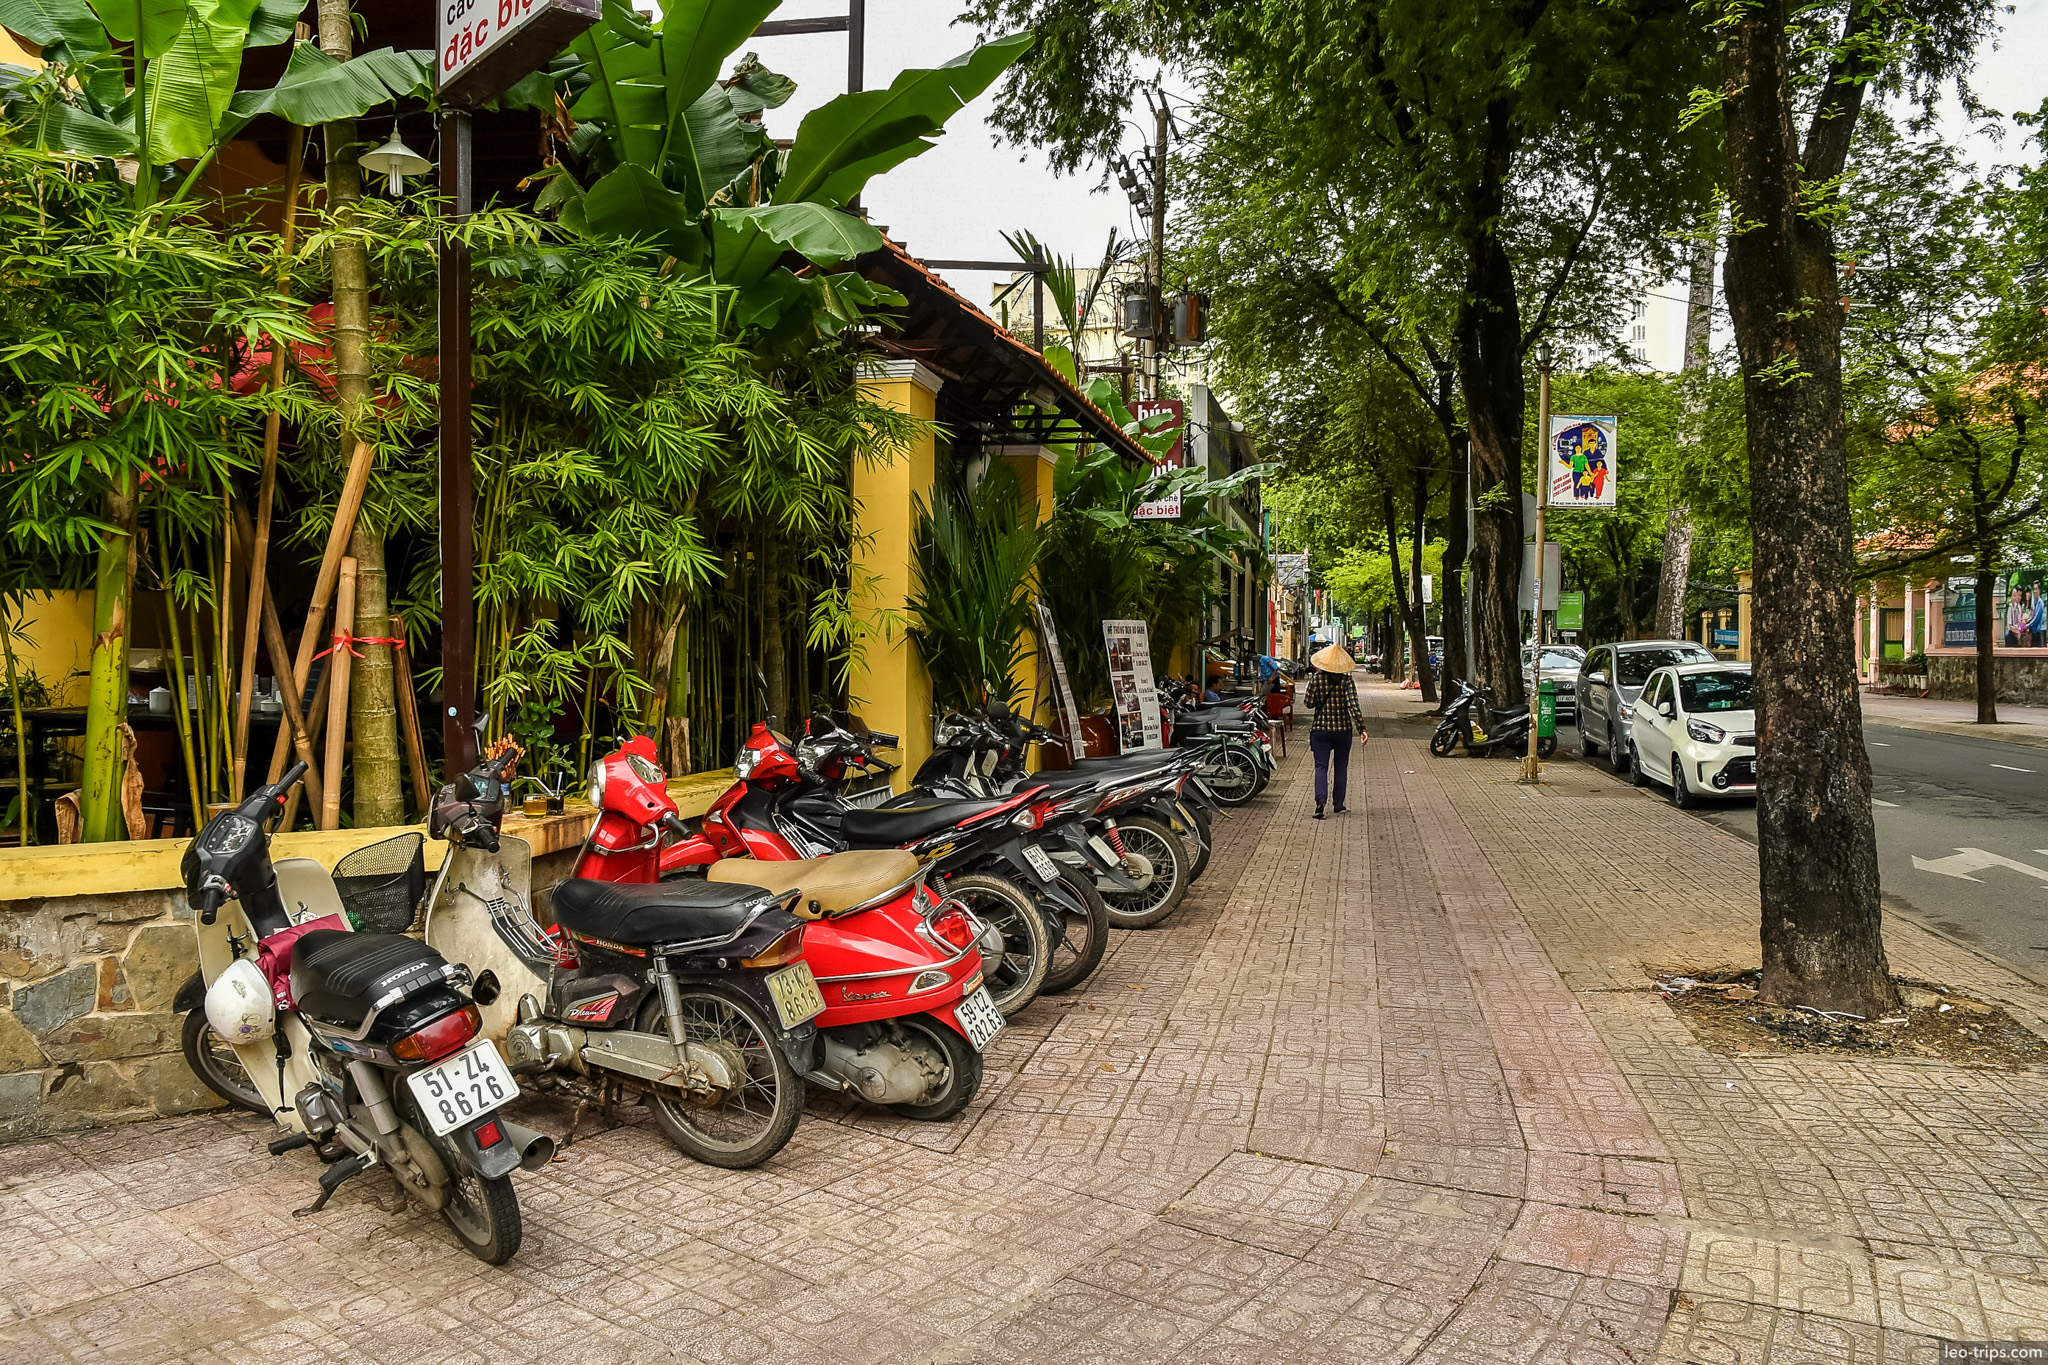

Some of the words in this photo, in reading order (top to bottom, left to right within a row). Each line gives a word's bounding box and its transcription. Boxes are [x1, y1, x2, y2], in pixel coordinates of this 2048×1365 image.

[444, 18, 489, 72] đặc
[1156, 505, 1179, 516] biệt
[596, 939, 625, 951] HONDA
[380, 962, 430, 988] HONDA
[784, 989, 819, 1022] 8616
[841, 985, 893, 1002] Vespa
[960, 991, 990, 1026] 59-C2
[969, 1008, 1003, 1048] 282.63
[438, 1075, 505, 1124] 8626
